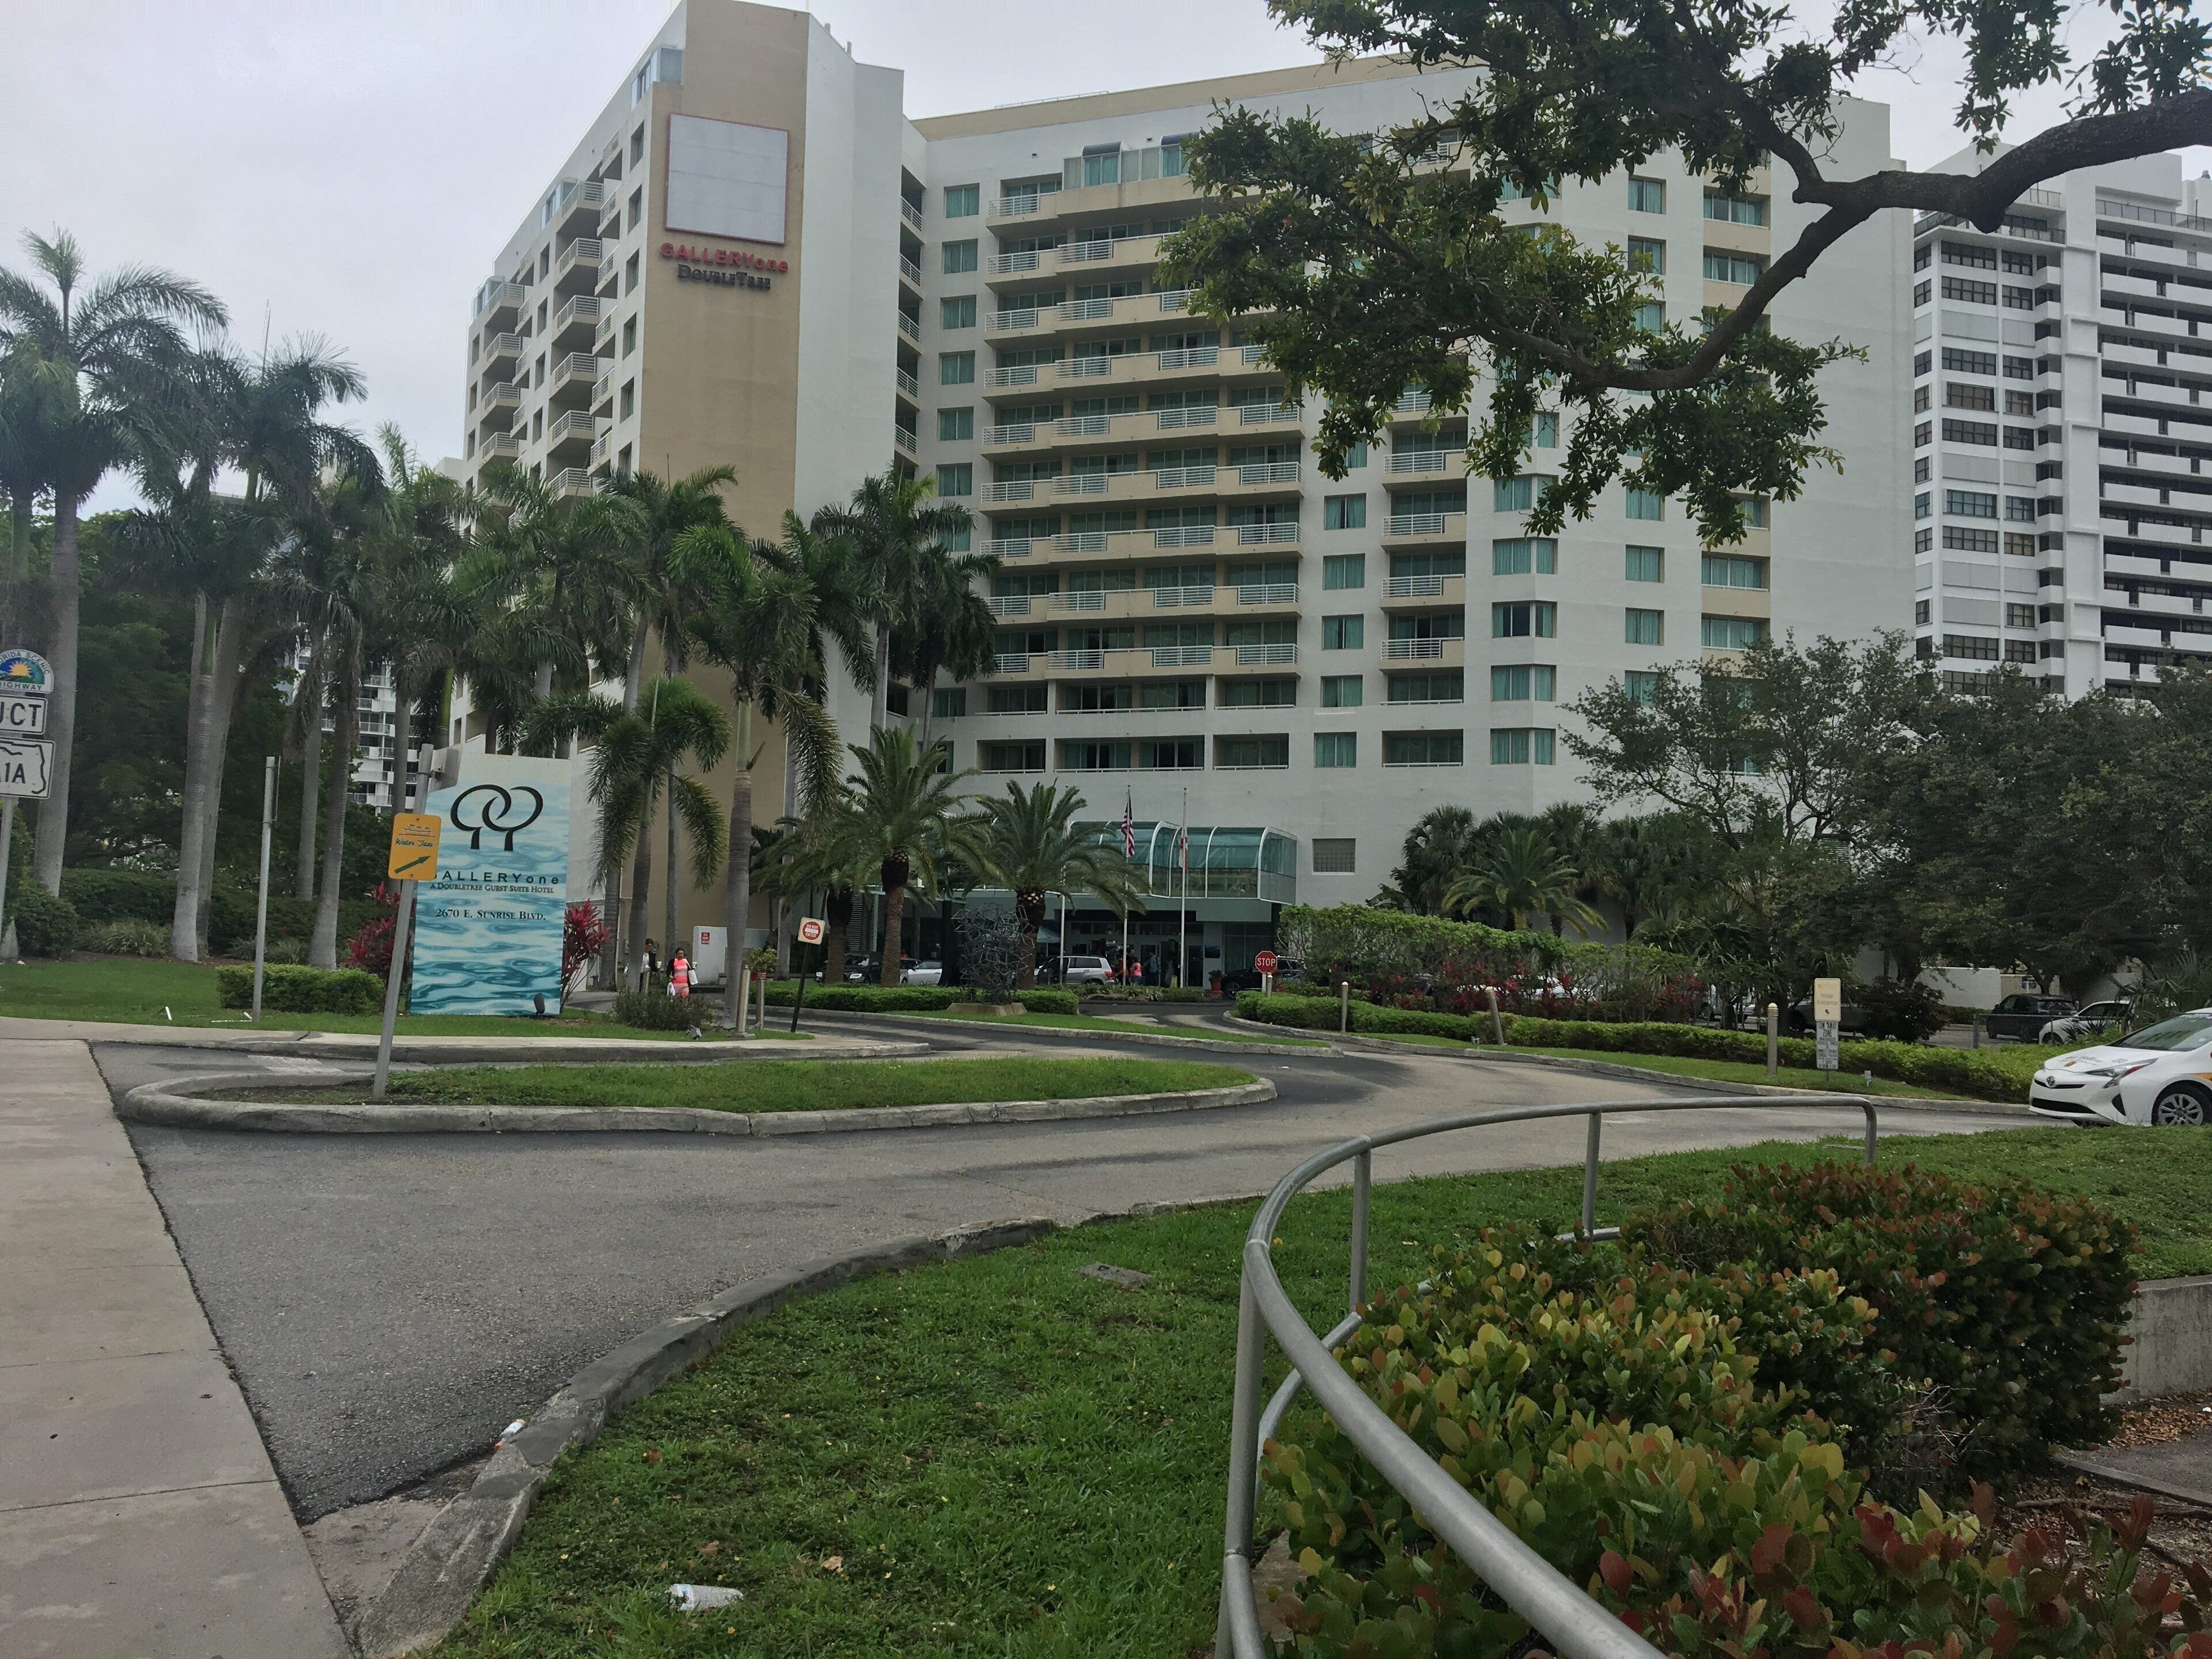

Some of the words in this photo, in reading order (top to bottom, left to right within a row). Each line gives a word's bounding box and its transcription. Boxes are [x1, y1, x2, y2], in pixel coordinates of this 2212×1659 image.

[660, 242, 789, 272] GALLERYone
[26, 653, 50, 675] SCENIC
[0, 762, 26, 783] 1A
[435, 870, 559, 884] ALLERYone
[435, 908, 459, 918] 2670
[464, 910, 472, 918] E.
[1257, 957, 1275, 966] STOP
